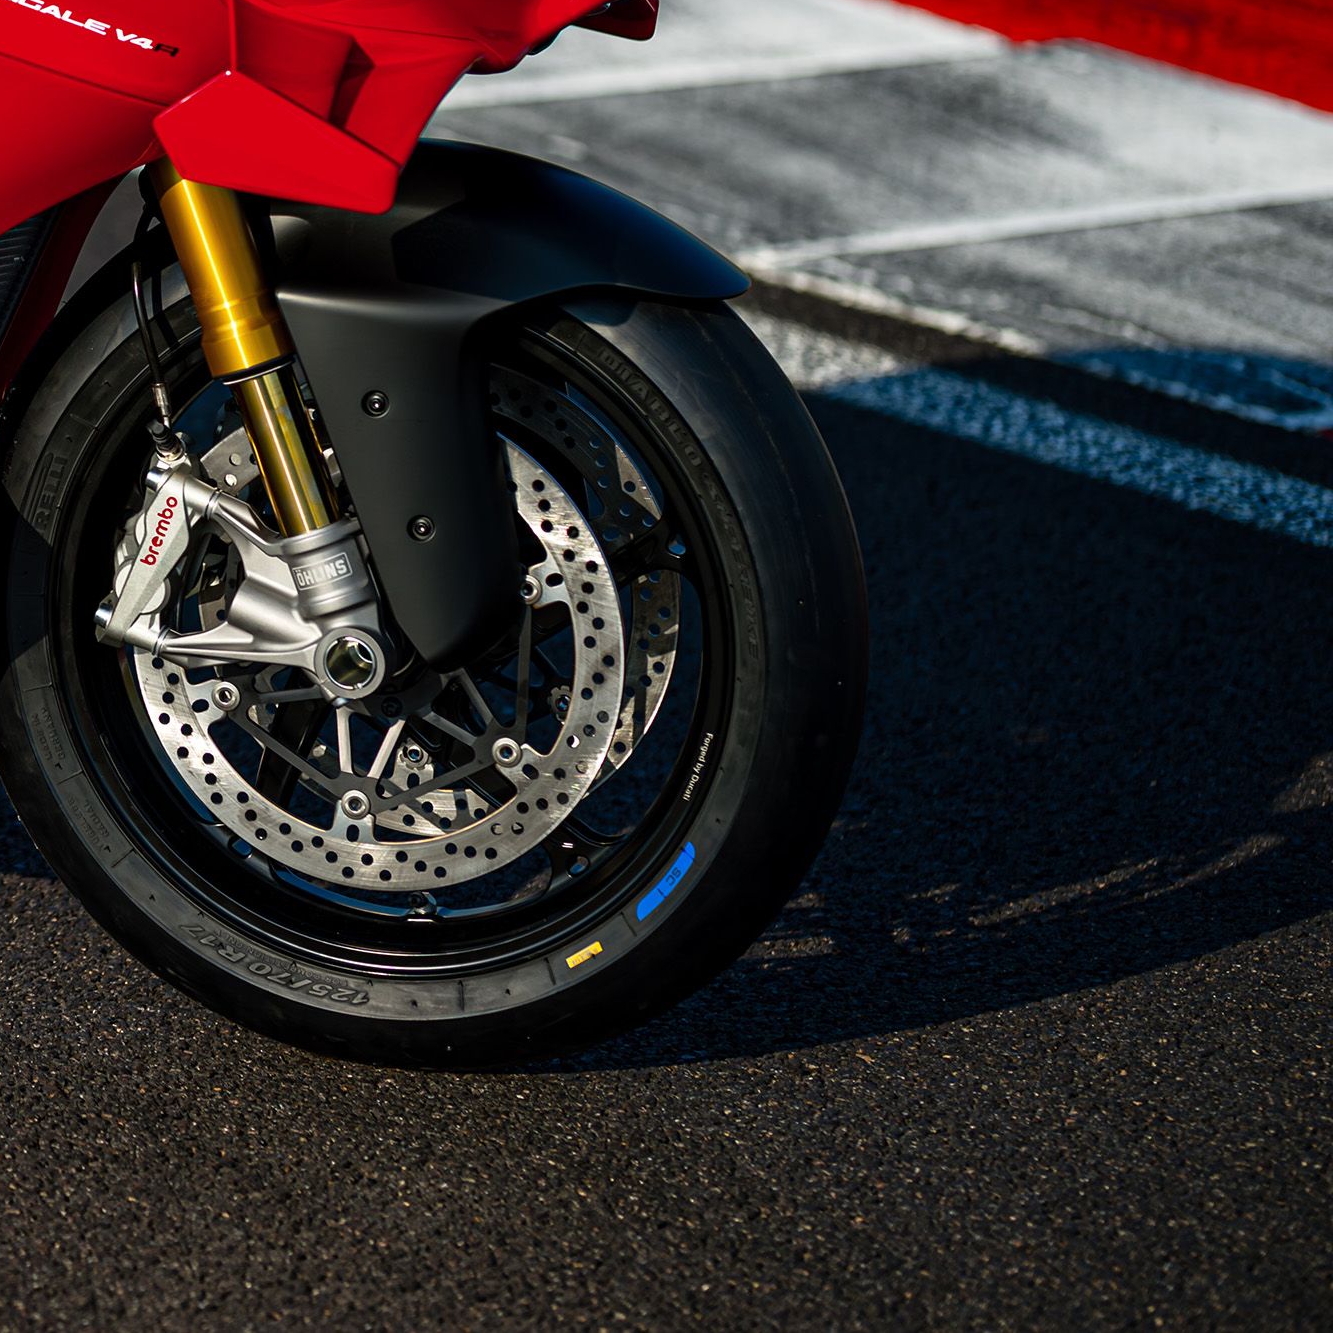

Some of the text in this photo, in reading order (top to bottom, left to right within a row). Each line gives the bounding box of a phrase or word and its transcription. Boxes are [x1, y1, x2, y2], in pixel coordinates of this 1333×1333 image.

[140, 496, 178, 566] brembo
[682, 732, 713, 801] Forged by Ducati
[248, 962, 370, 1006] 125/70
